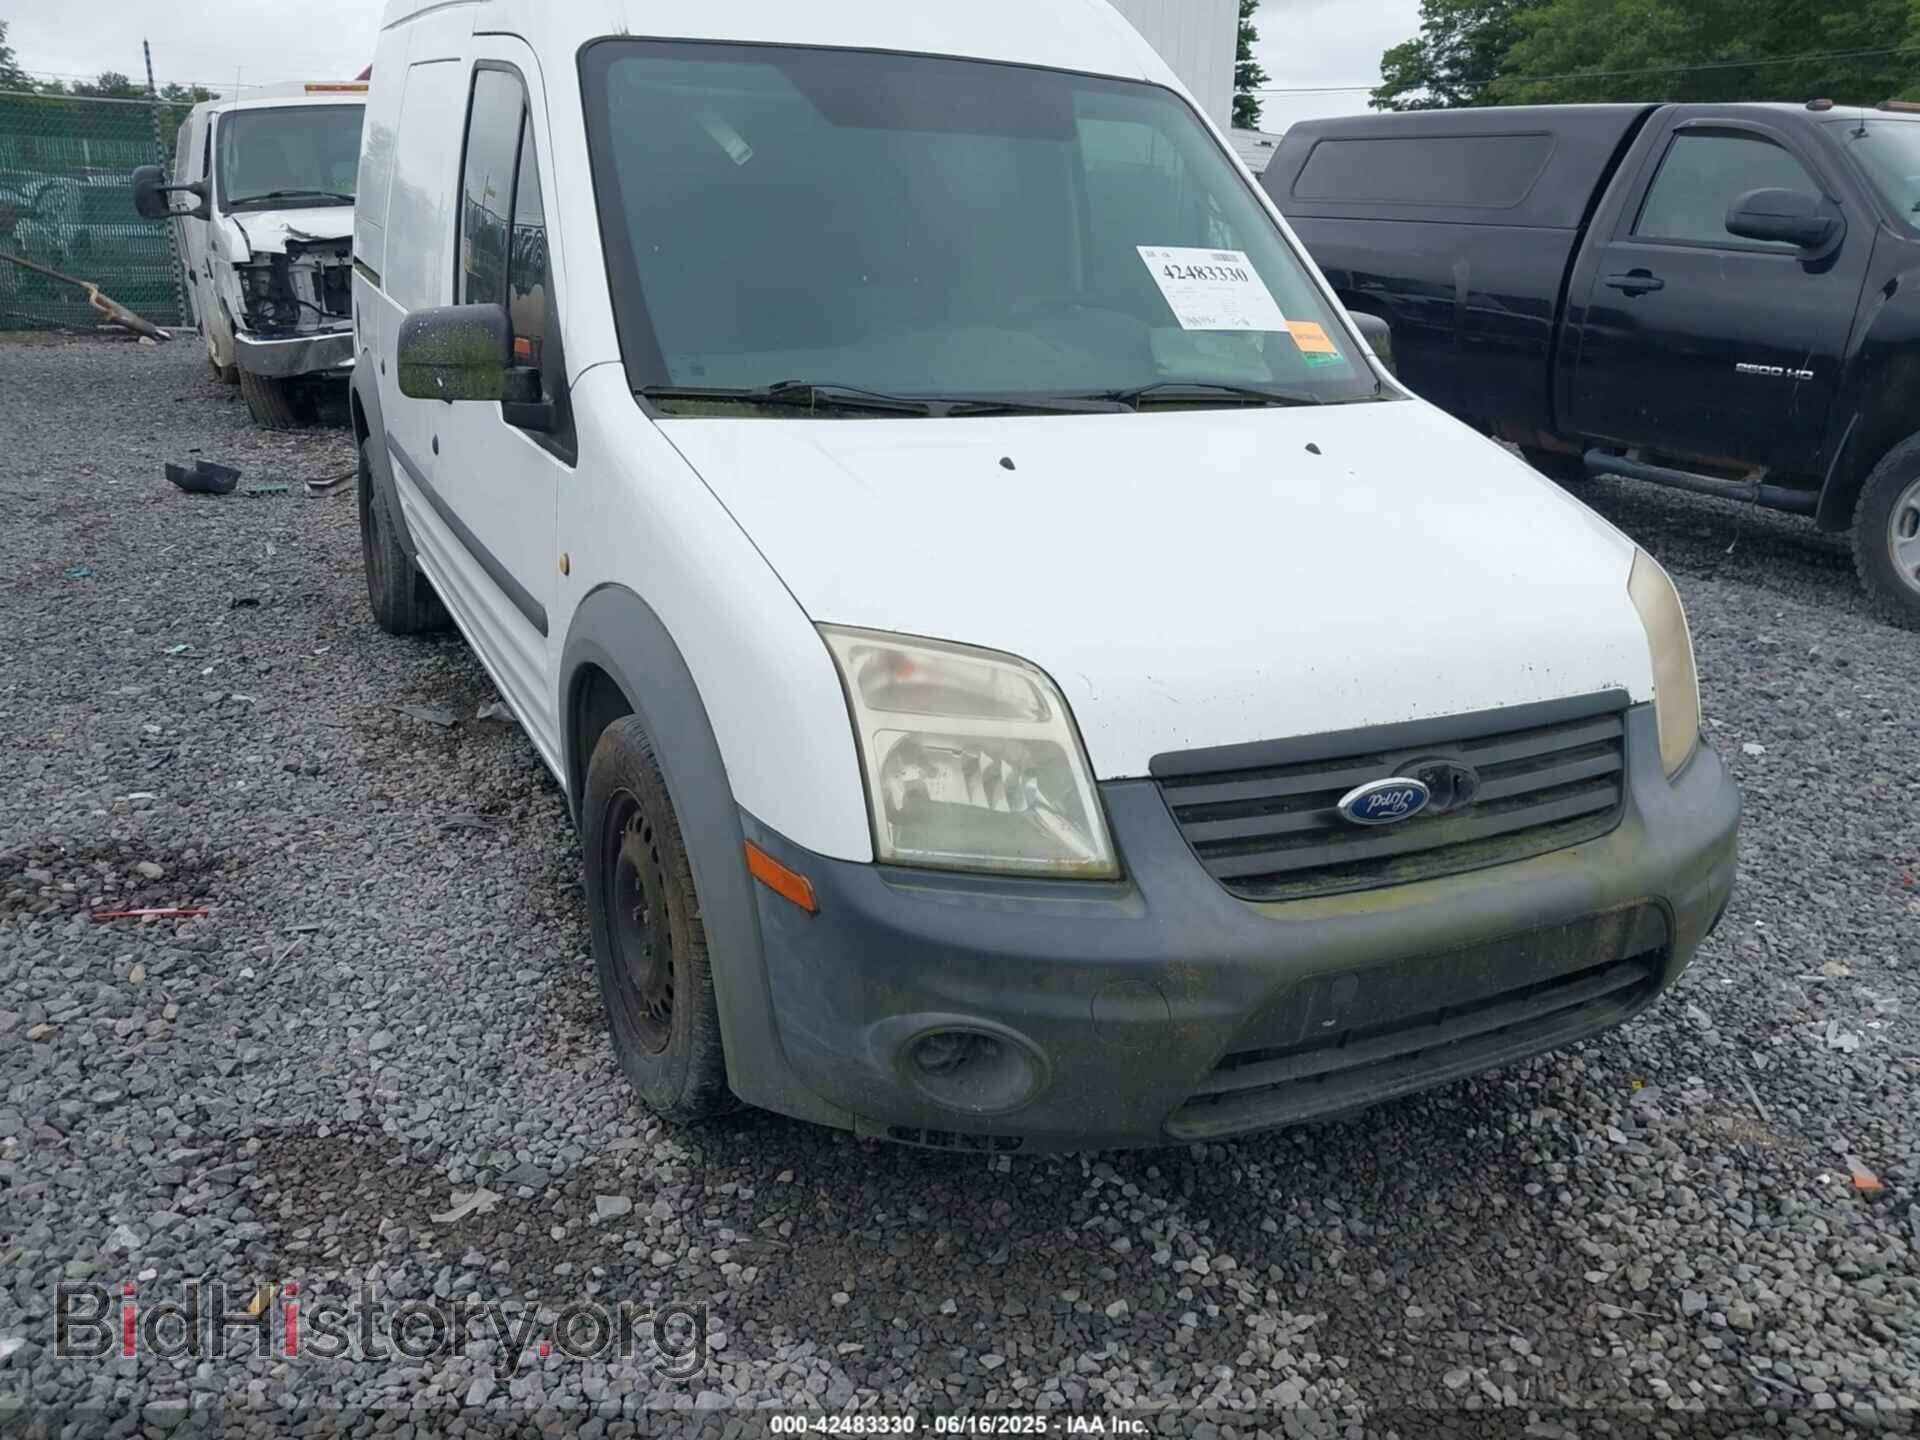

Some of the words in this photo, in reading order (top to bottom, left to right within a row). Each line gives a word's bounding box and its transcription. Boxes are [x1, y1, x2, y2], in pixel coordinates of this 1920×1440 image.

[1163, 264, 1249, 283] 42483330
[1786, 368, 1814, 380] HD
[1366, 790, 1413, 816] Ford
